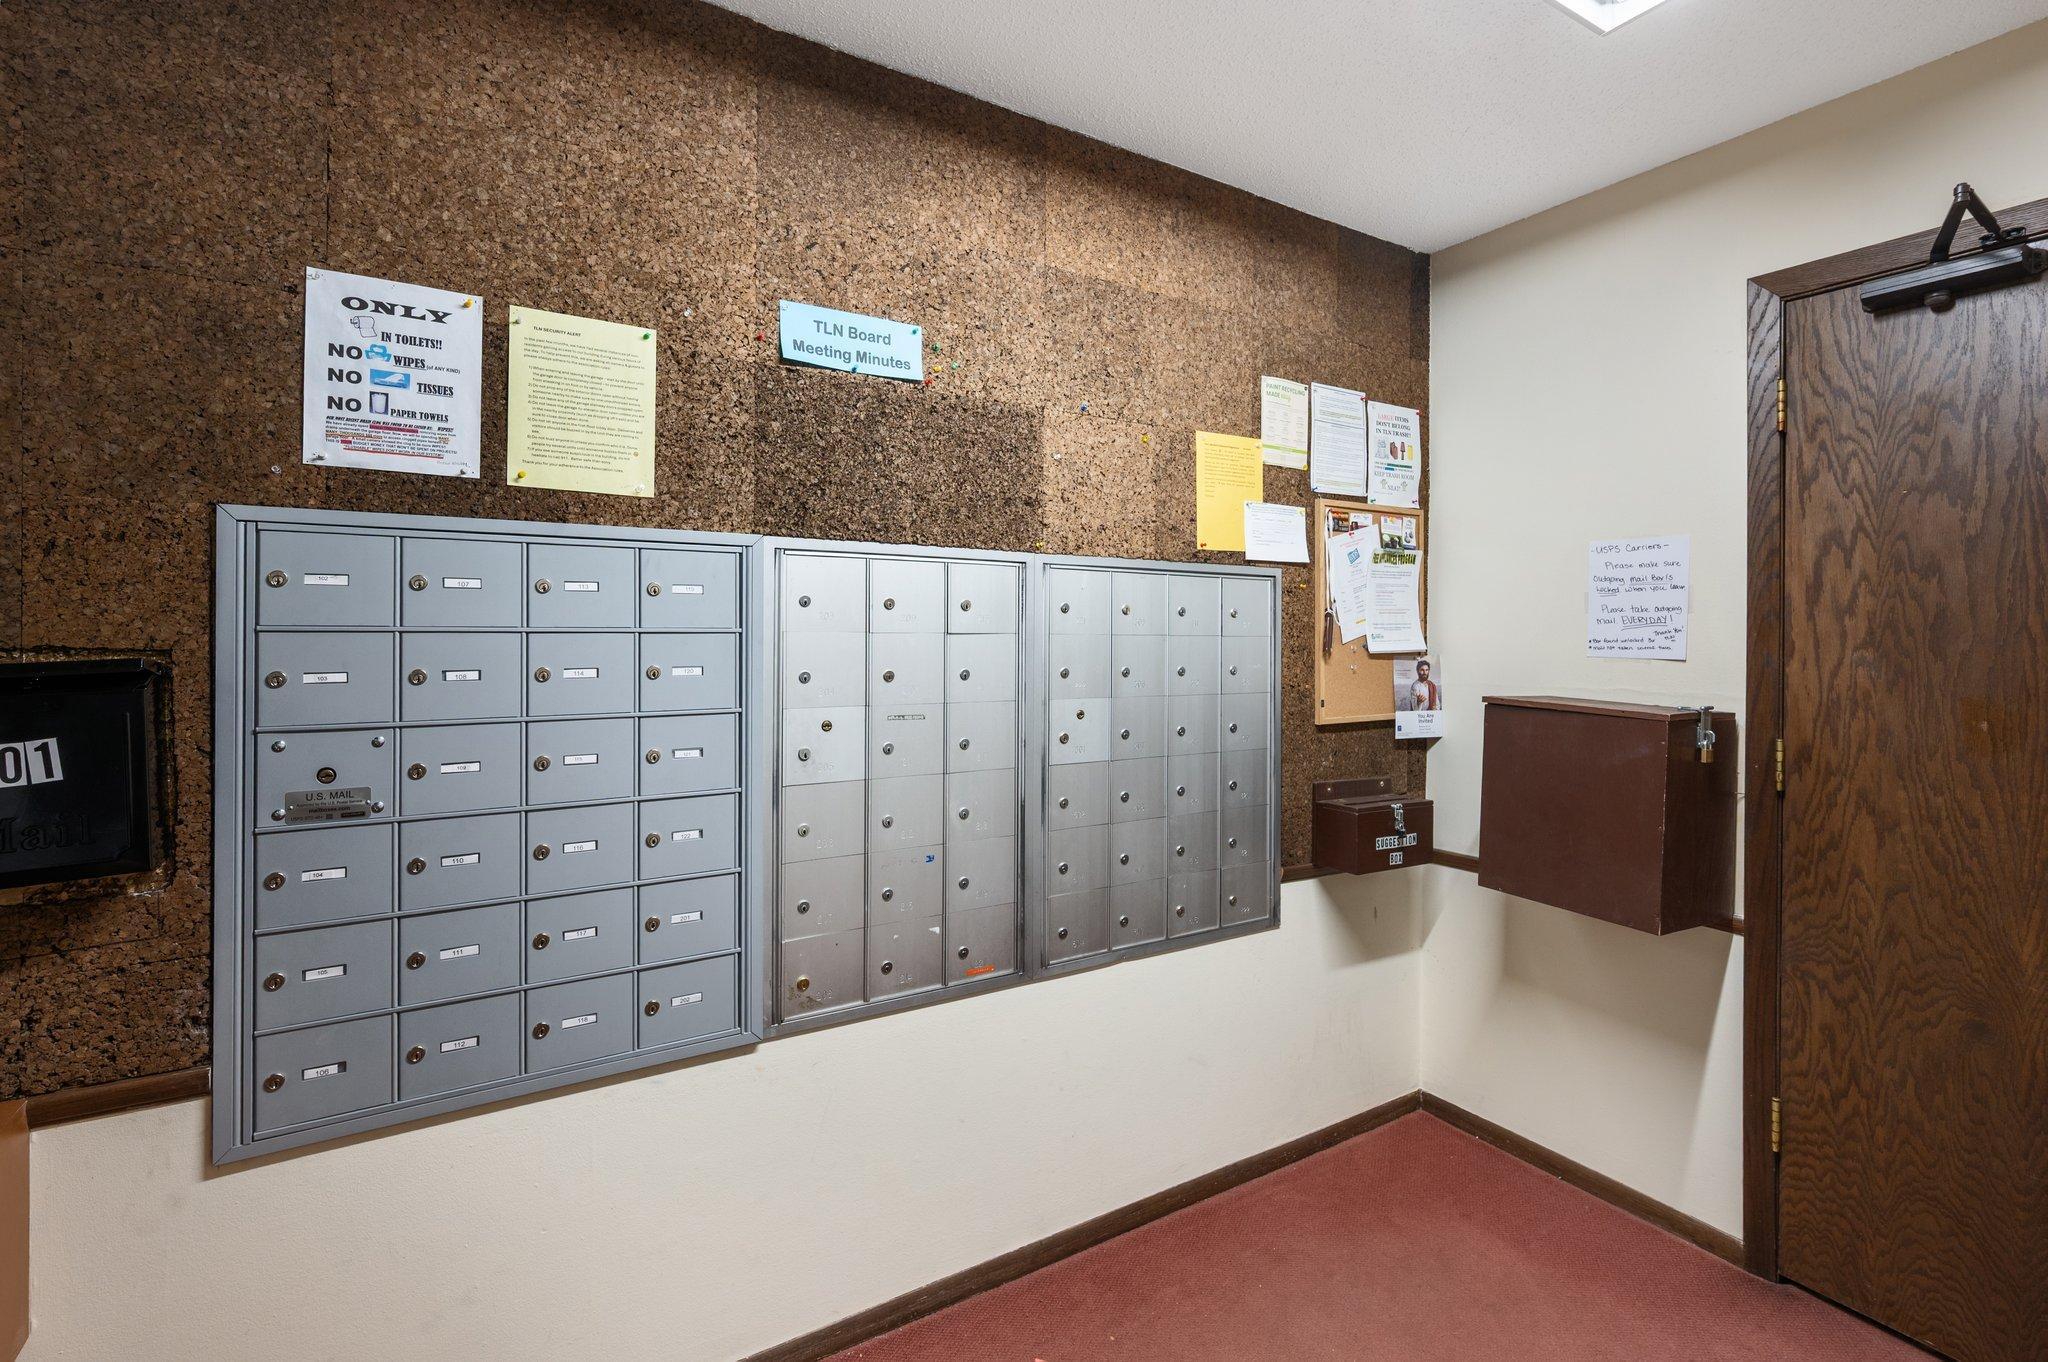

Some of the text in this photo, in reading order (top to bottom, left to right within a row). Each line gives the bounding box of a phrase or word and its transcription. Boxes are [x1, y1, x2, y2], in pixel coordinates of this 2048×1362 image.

[341, 296, 453, 324] ONLY
[381, 331, 442, 350] IN TOILETS!!
[545, 327, 566, 335] SECURITY
[813, 320, 891, 345] TLN Board
[328, 343, 363, 359] NO
[393, 355, 426, 369] WIPES
[792, 339, 911, 370] Meeting Minutes
[328, 368, 454, 397] NO TISSUES
[327, 396, 449, 423] NO PAPER TOWELS
[1596, 545, 1621, 554] USPS
[1605, 561, 1633, 570] Please
[1601, 604, 1626, 613] Please
[1630, 603, 1650, 612] take
[306, 790, 354, 801] U.S. MAIL
[0, 815, 96, 854] ail
